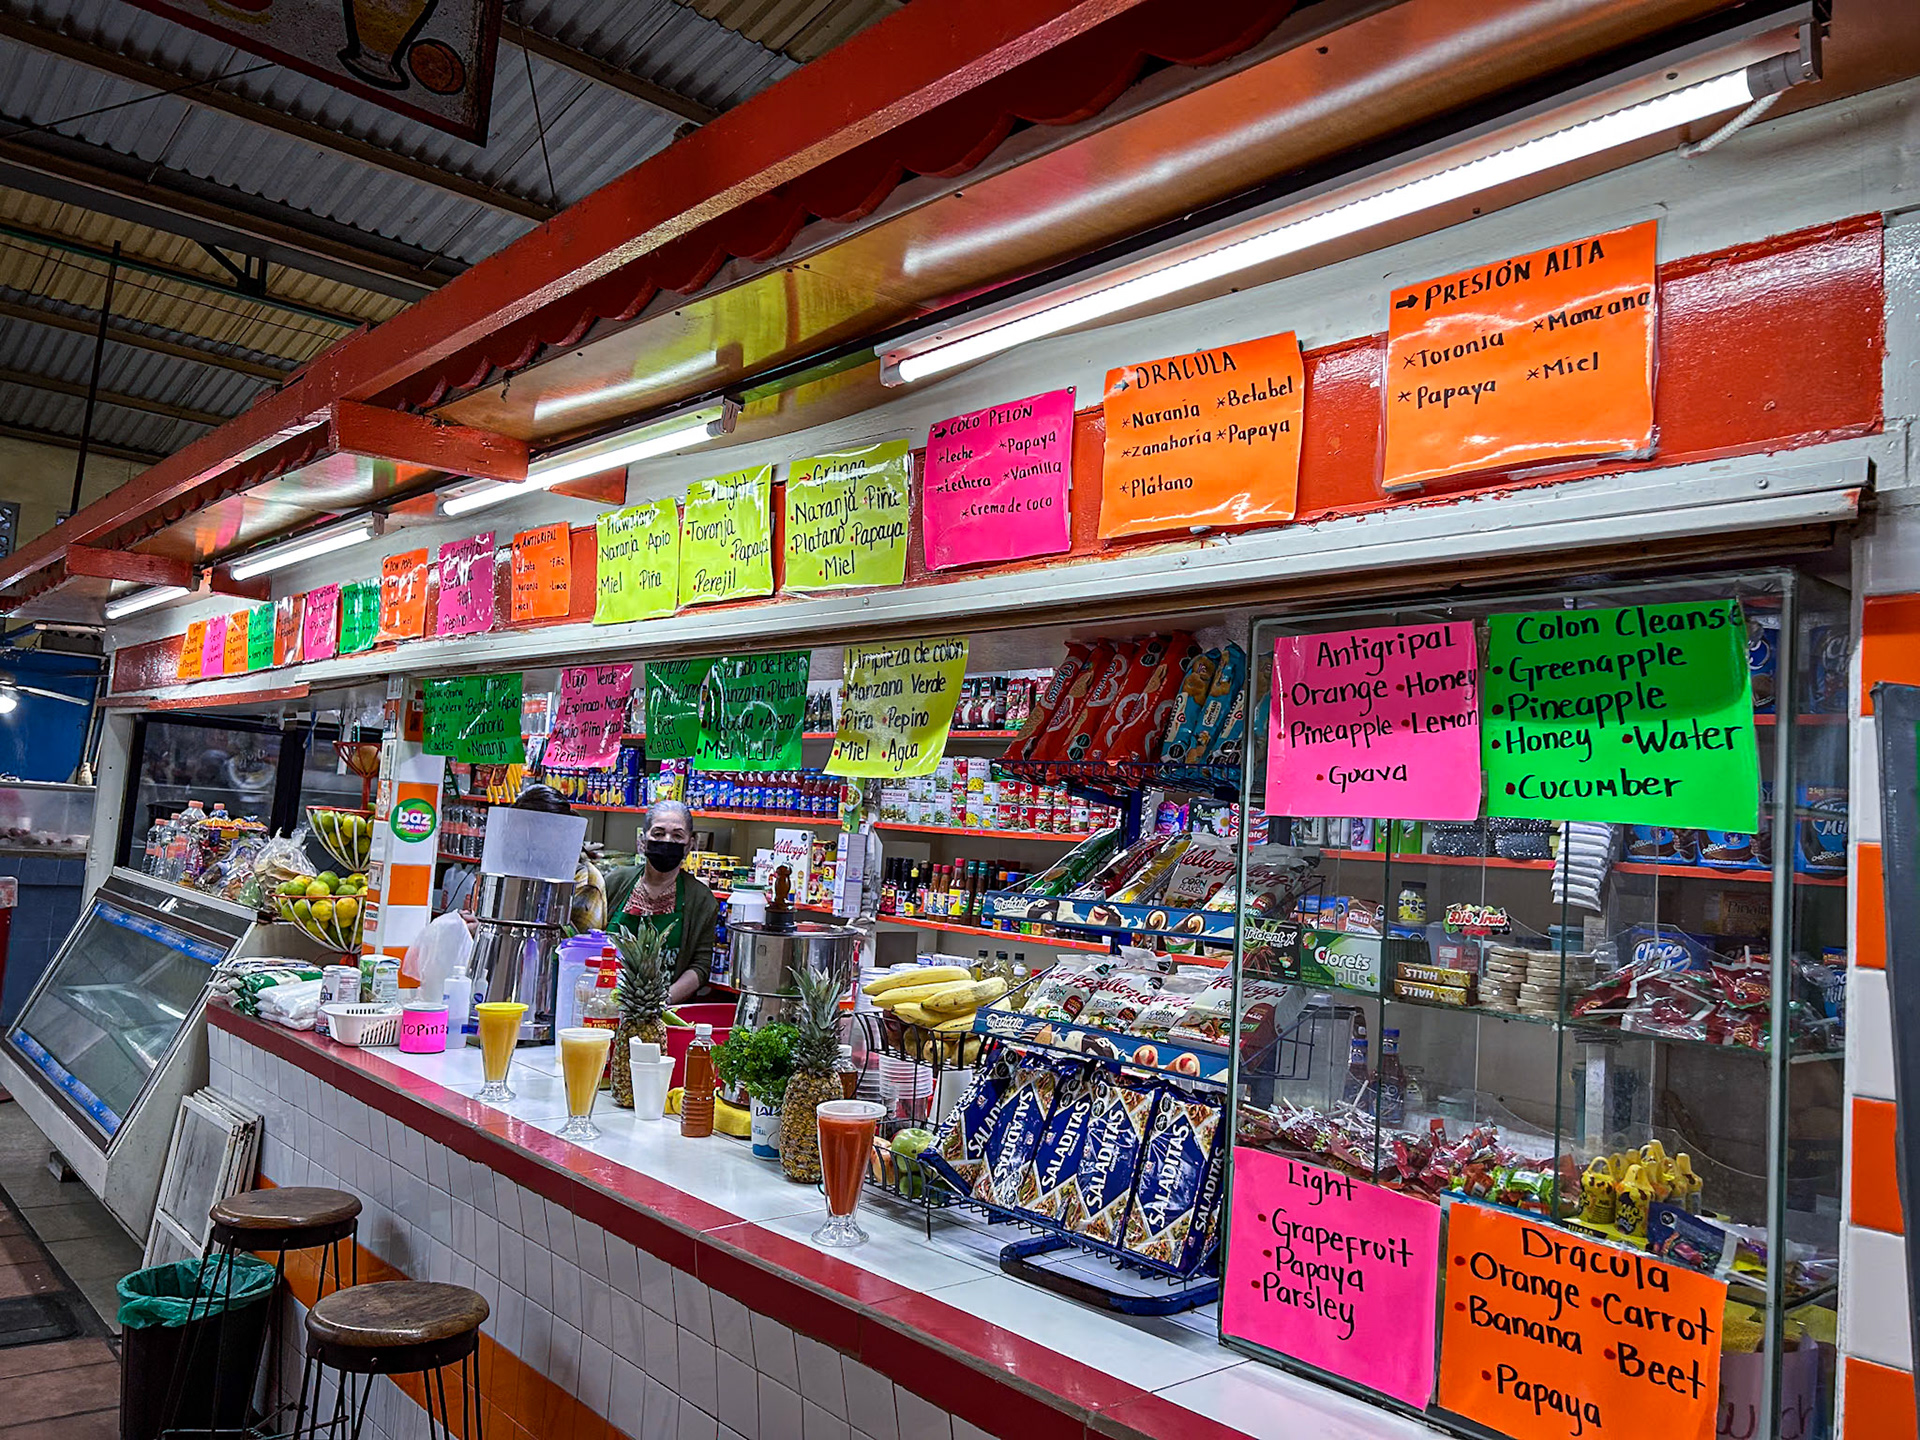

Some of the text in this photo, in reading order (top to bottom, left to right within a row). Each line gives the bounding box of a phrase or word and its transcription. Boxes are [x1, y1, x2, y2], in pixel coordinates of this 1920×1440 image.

[1424, 239, 1605, 311] PRESIÓN ALTA
[1548, 291, 1652, 331] Manzana
[1416, 331, 1505, 368] Toronja
[1543, 351, 1599, 379] Miel
[1132, 375, 1294, 429] Naranja Betabel
[1416, 379, 1497, 409] Papaya
[949, 402, 1034, 437] COCO PELÓN
[1228, 419, 1291, 446] Papaya
[1007, 430, 1056, 455] Papaya
[1010, 460, 1062, 483] Vainilla
[795, 485, 901, 526] Naranja Piña
[970, 496, 1053, 517] Crema de coco
[601, 530, 671, 562] Naranja Apio
[688, 514, 737, 548] Toronja
[852, 521, 905, 551] Papaya
[732, 538, 769, 566] Papaya
[824, 549, 855, 580] Miel
[600, 569, 662, 595] Miel Piña
[694, 567, 737, 596] Perejil
[1516, 604, 1742, 644] Colon Cleanse
[761, 655, 776, 674] de
[848, 644, 911, 676] Limpieza
[914, 641, 930, 664] de
[1316, 625, 1456, 677] Antigripal
[566, 665, 618, 695] Jugo Verde
[1508, 642, 1688, 692] Greenapple
[846, 671, 947, 702] Manzana Verde
[1291, 668, 1477, 717] Orange Honey
[501, 694, 519, 713] Apio
[564, 697, 600, 717] Espinaca
[1508, 682, 1668, 729] Pineapple
[556, 723, 580, 743] Apio
[582, 721, 601, 737] Piña
[843, 706, 929, 734] Piña Pepino
[1290, 710, 1478, 749] Pineapple Lemon
[471, 738, 508, 761] Naranja
[554, 744, 587, 768] Perejil
[651, 737, 688, 757] Celery
[704, 740, 734, 760] Miel
[838, 738, 919, 772] Miel Agua
[1506, 718, 1743, 763] Honey Water
[1328, 764, 1408, 794] Guava
[1518, 768, 1683, 800] Cucumber
[398, 806, 432, 824] baz
[773, 839, 809, 861] Kellogg's
[1182, 876, 1207, 887] CORN
[1244, 927, 1286, 944] Trident
[1314, 946, 1371, 971] Clorets
[1405, 968, 1438, 981] HALLS
[1400, 984, 1435, 999] HALLS
[1149, 1008, 1176, 1018] CORN
[994, 1089, 1034, 1180] SALADITAS
[1042, 1100, 1091, 1189] SALADITAS
[1087, 1109, 1126, 1209] SALADITAS
[1150, 1124, 1190, 1229] SALADITAS
[1195, 1148, 1225, 1233] SALADITAS
[1288, 1162, 1358, 1206] Light
[1271, 1208, 1414, 1267] Grapefruit
[1275, 1246, 1364, 1295] Papaya
[1521, 1227, 1669, 1293] Dracula
[1263, 1271, 1355, 1341] Parsley
[1470, 1252, 1715, 1345] Orange Carrot
[1469, 1295, 1706, 1399] Banana Beet
[1496, 1363, 1602, 1437] Papaya
